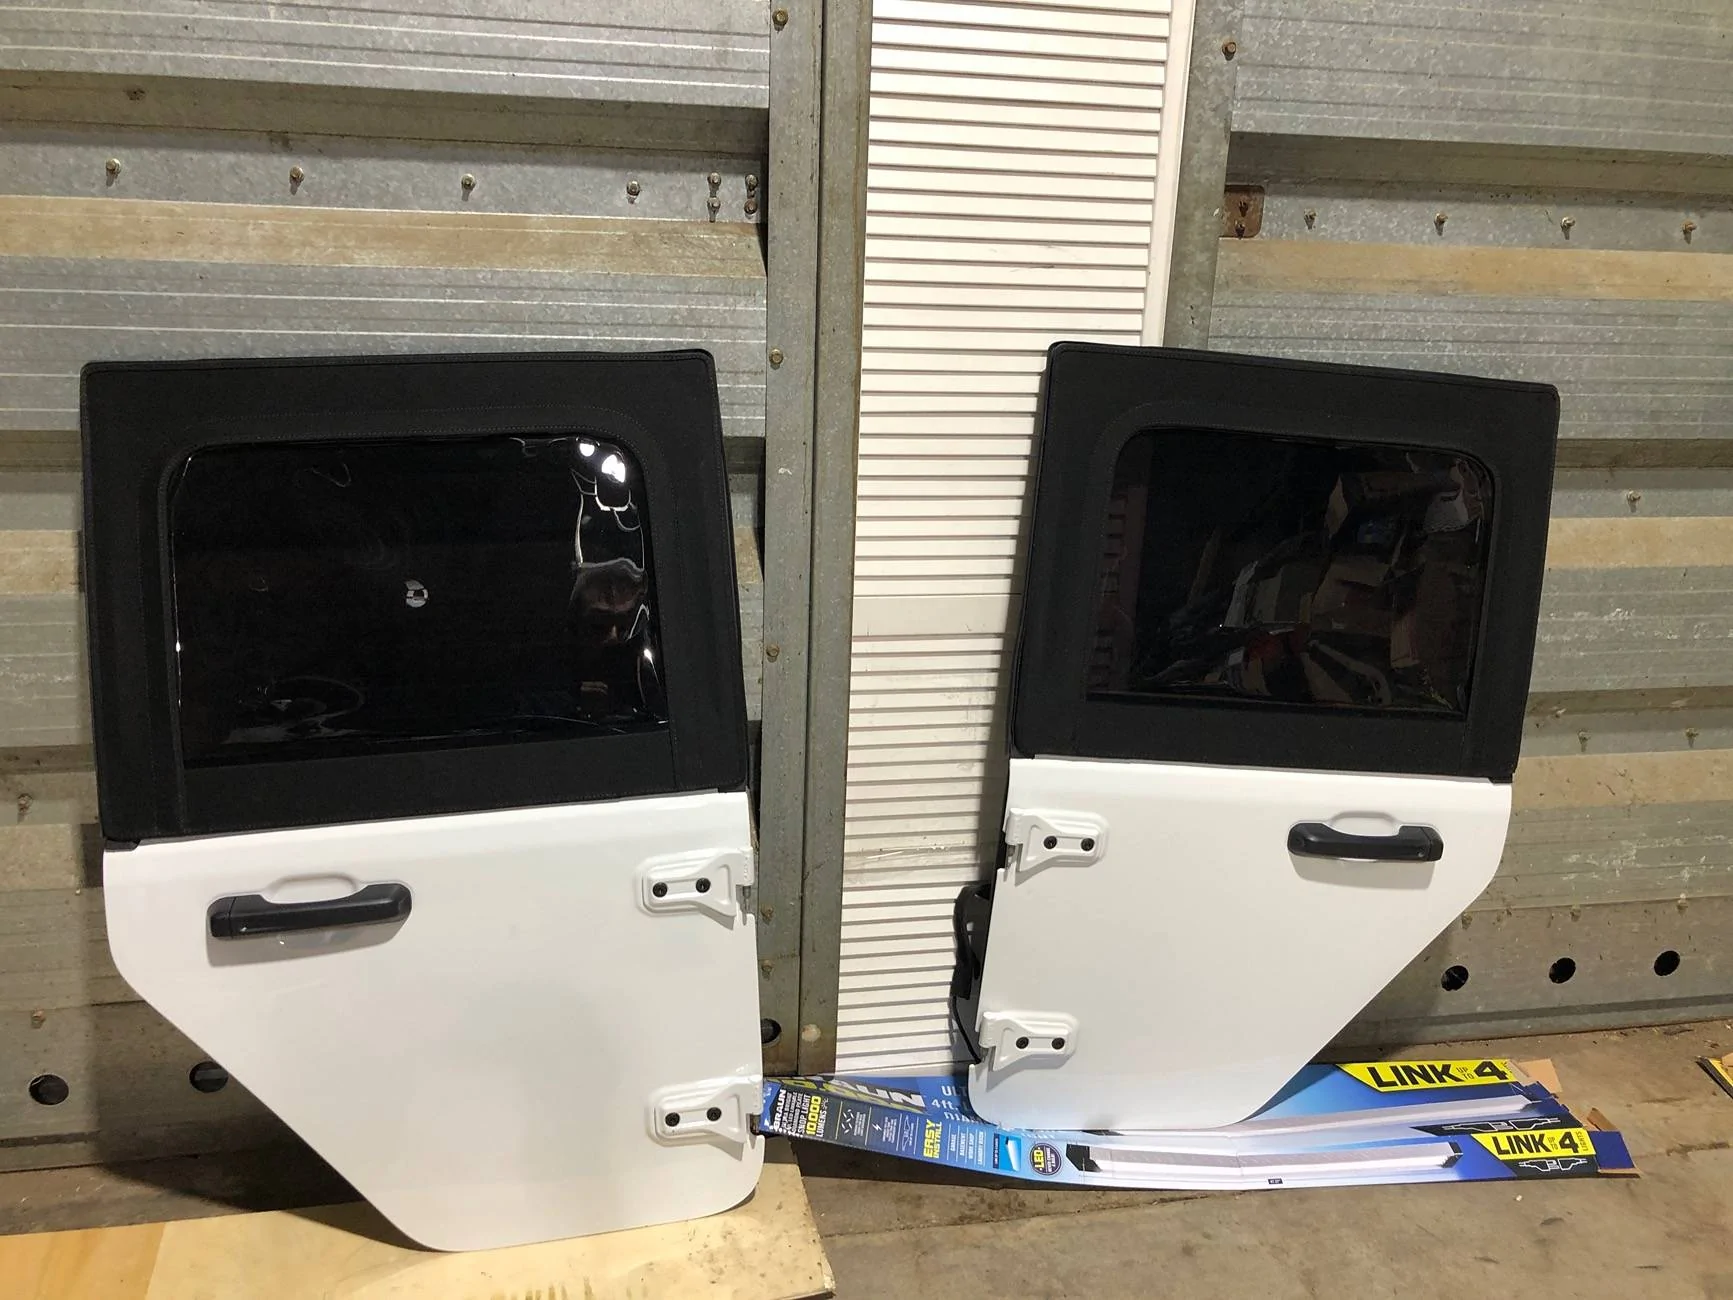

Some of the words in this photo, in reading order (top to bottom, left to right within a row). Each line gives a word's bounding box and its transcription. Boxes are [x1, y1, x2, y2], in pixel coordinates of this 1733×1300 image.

[1367, 1064, 1465, 1087] LINK
[1474, 1061, 1508, 1080] 4
[773, 1089, 787, 1131] BRAUN
[802, 1094, 811, 1114] LIGHT
[816, 1110, 827, 1138] LUMENS
[923, 1118, 936, 1158] EASY
[932, 1121, 942, 1159] INSTALL
[1491, 1134, 1553, 1155] LINK
[1558, 1131, 1579, 1153] 4
[1033, 1149, 1044, 1168] LED
